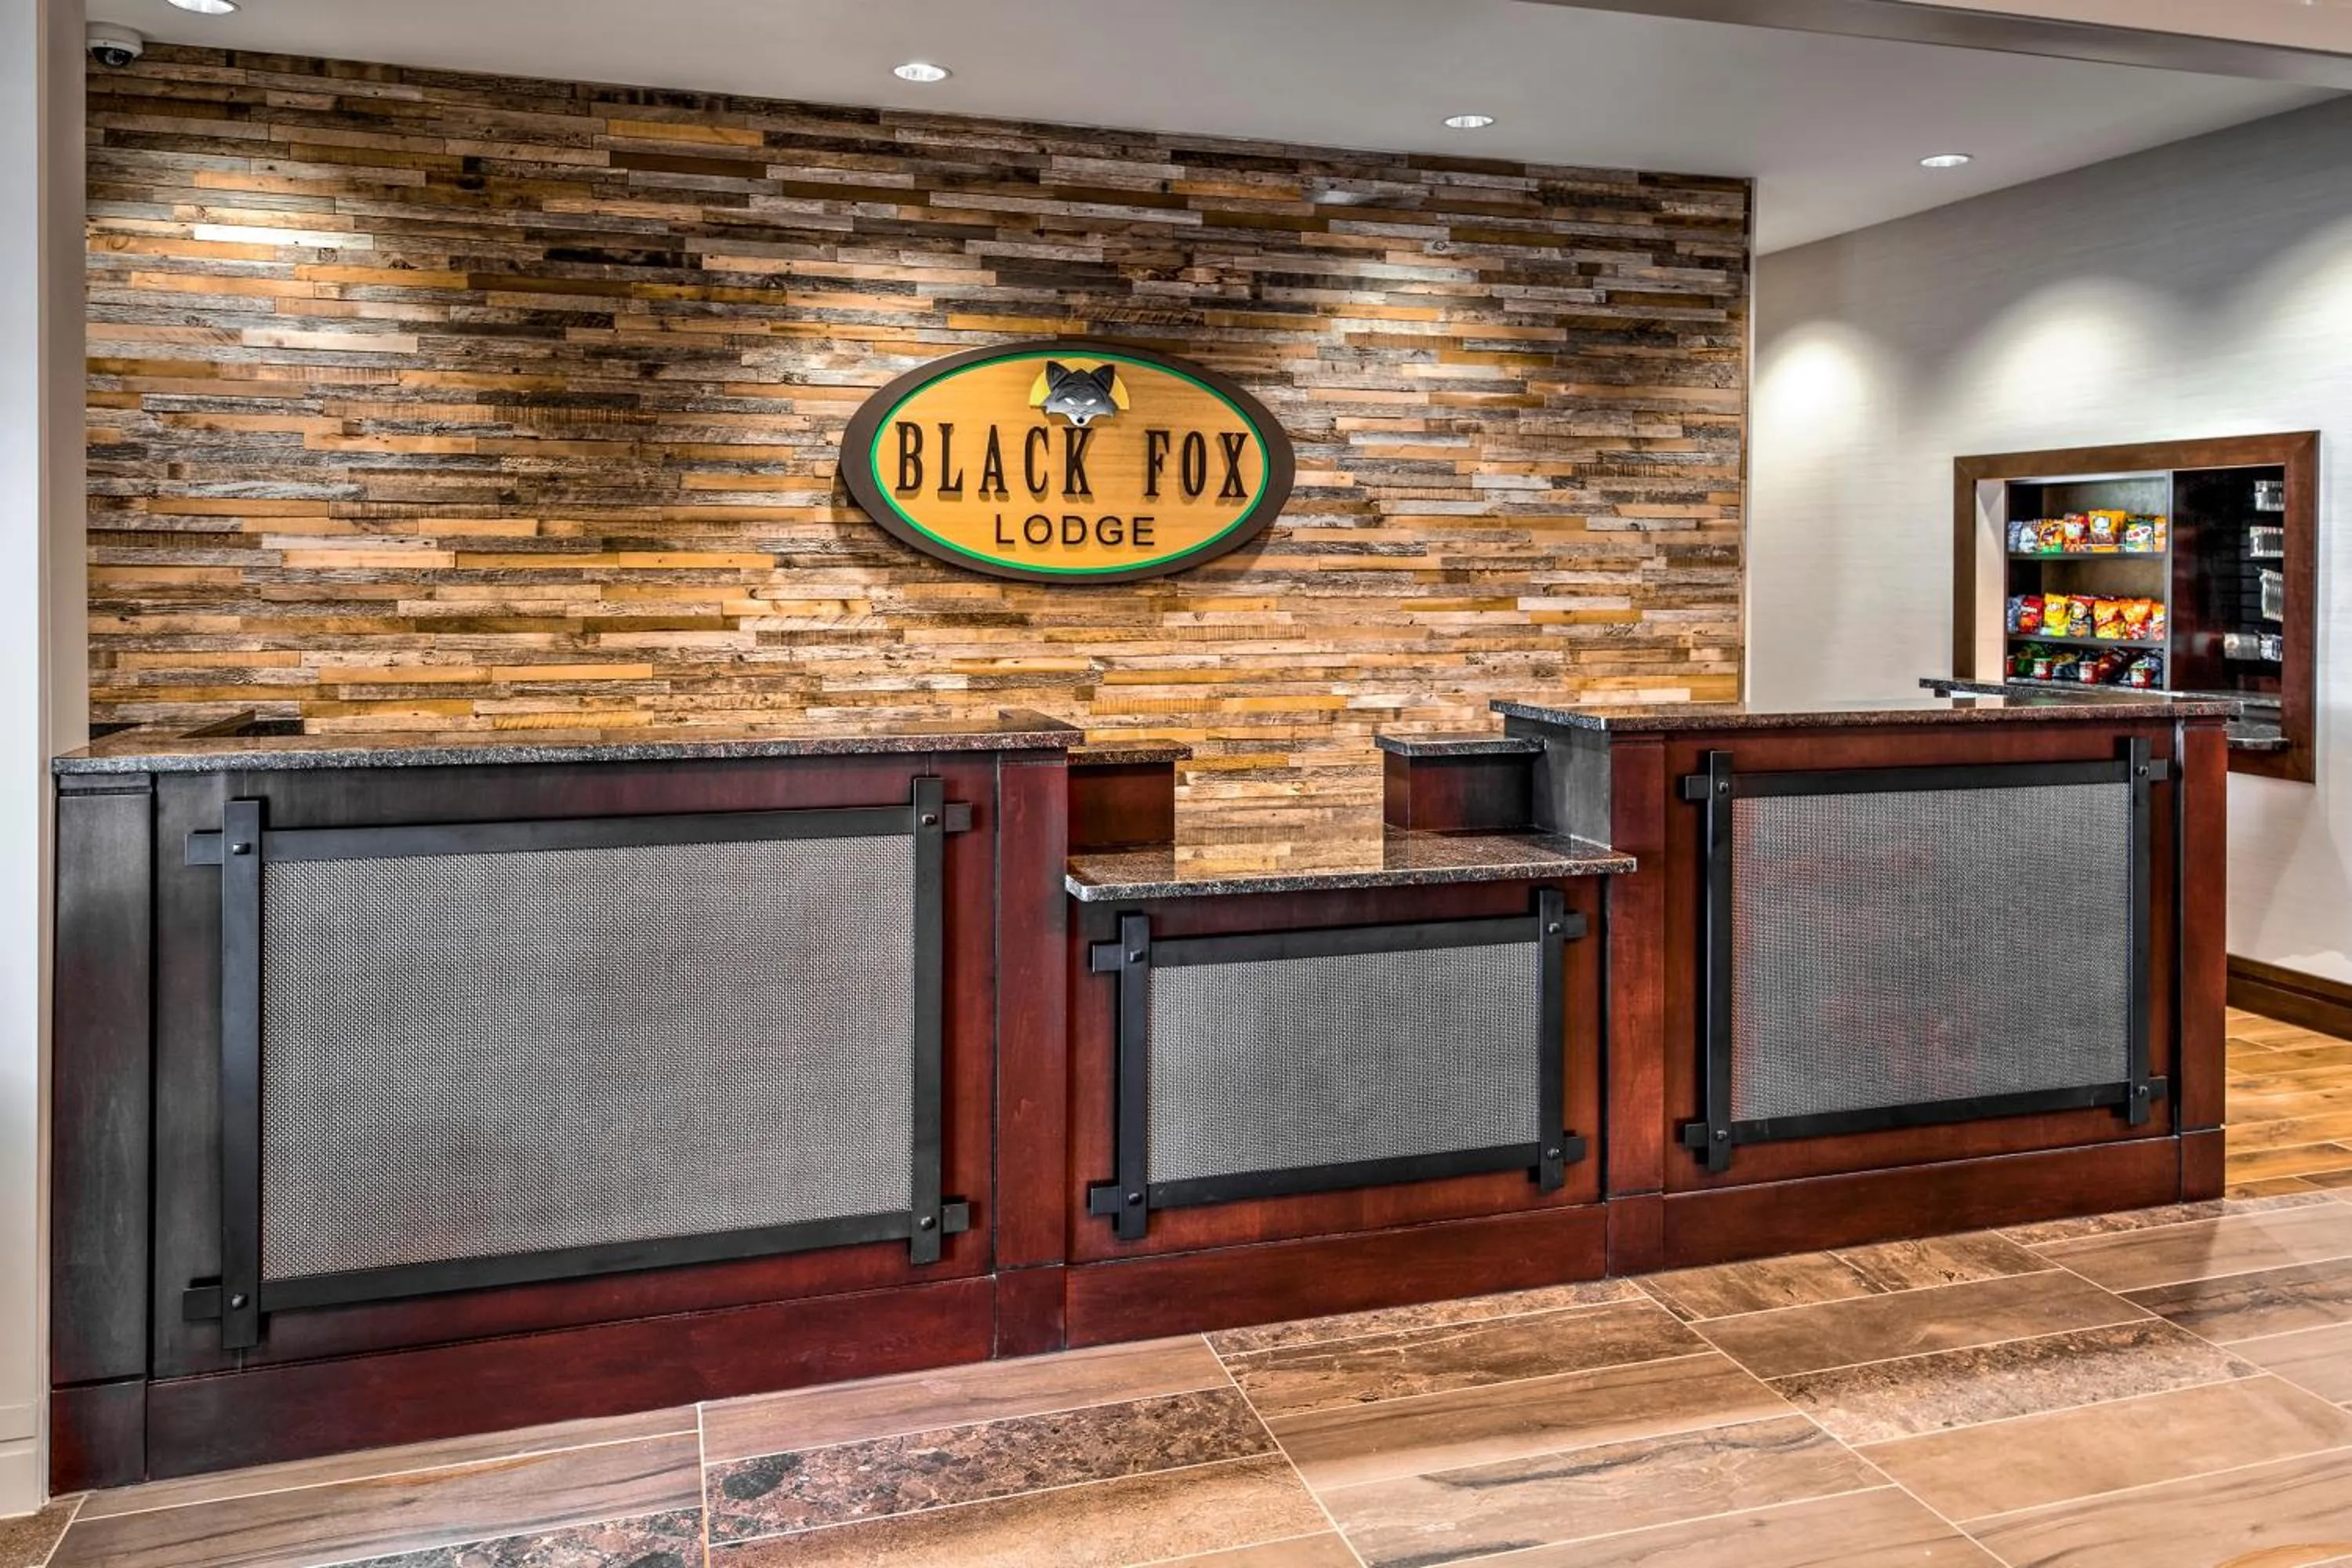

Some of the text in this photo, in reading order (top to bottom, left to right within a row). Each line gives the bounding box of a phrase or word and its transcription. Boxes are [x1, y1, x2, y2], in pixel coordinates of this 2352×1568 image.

[895, 420, 1249, 499] BLACK FOX
[995, 513, 1156, 546] LODGE
